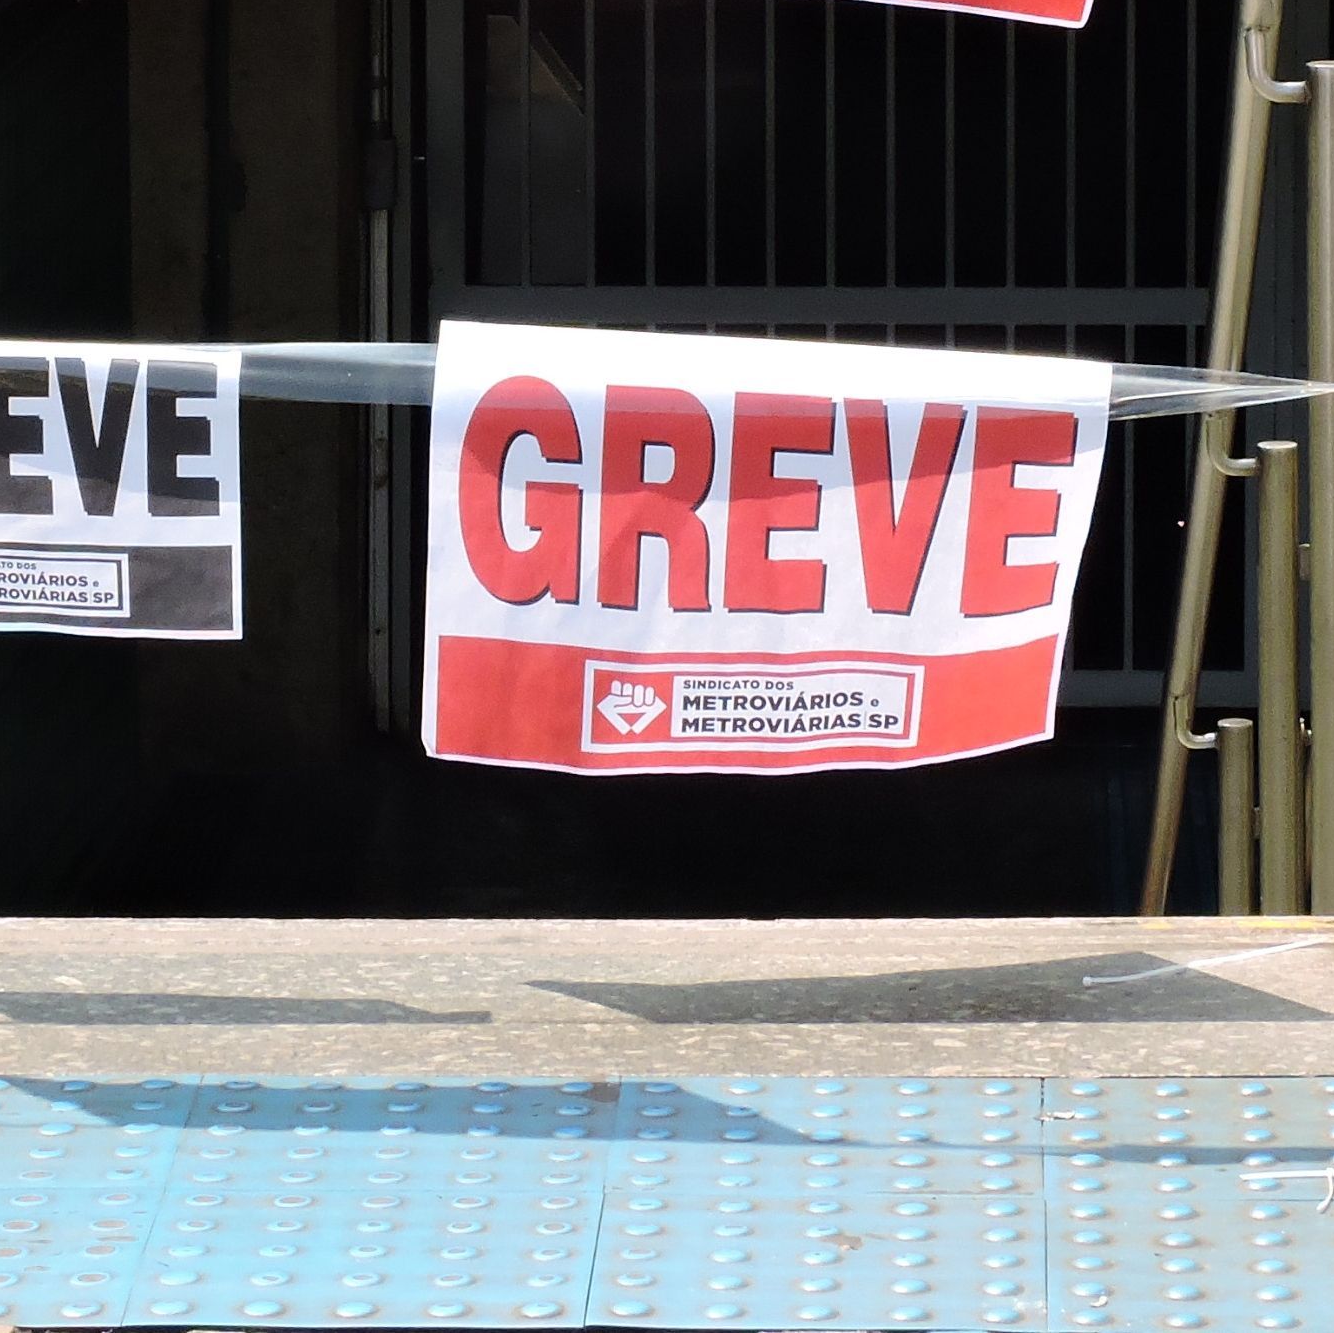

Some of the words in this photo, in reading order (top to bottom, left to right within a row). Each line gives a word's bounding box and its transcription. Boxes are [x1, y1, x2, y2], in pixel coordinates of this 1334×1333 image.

[458, 375, 1079, 618] GREVE
[93, 592, 114, 603] SP
[683, 680, 760, 690] SINDICATO
[765, 681, 794, 690] DOS
[683, 691, 863, 711] METROVIÁRIOS
[682, 713, 861, 733] METROVIÁRIAS
[868, 714, 898, 729] SP
